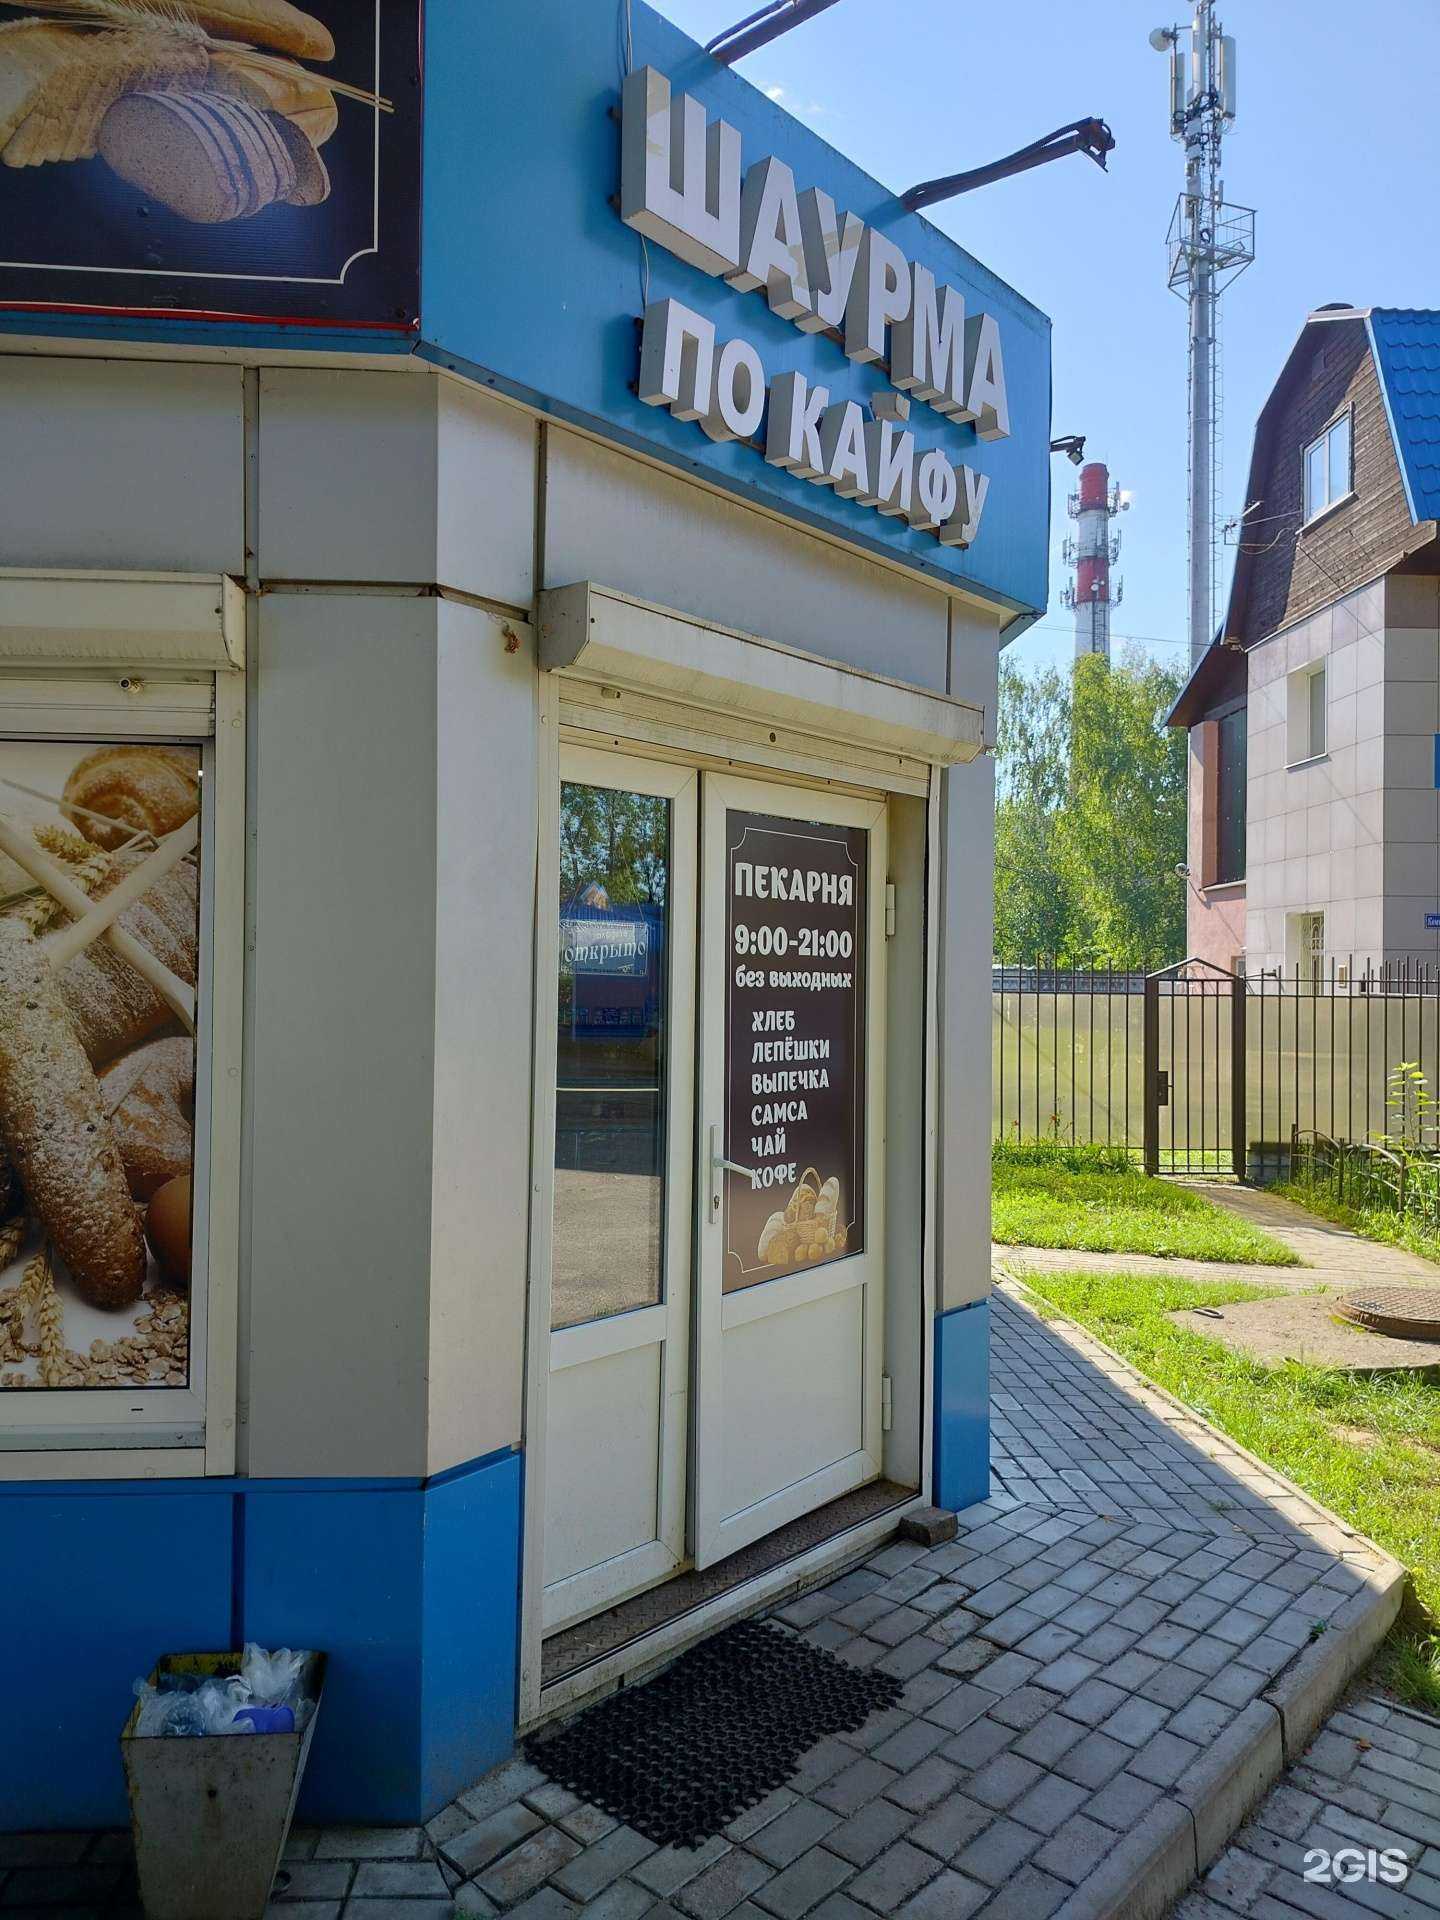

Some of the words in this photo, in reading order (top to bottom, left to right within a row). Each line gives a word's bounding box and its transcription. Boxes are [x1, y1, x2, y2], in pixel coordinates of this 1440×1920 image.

[622, 65, 1010, 440] ШАУРМА
[640, 298, 766, 442] ПО
[766, 370, 990, 546] КАЙФУ
[734, 862, 853, 906] ПЕКАРНЯ
[564, 941, 646, 965] открыто
[734, 924, 853, 958] 9:00-21:00
[735, 964, 765, 988] без
[769, 969, 852, 992] выходных
[751, 1010, 796, 1032] ХЛЕБ
[751, 1036, 830, 1063] ЛЕПЁШКИ
[751, 1068, 830, 1095] ВЫПЕЧКА
[751, 1100, 808, 1126] САМСА
[751, 1127, 786, 1157] ЧАЙ
[751, 1162, 797, 1190] КОФЕ
